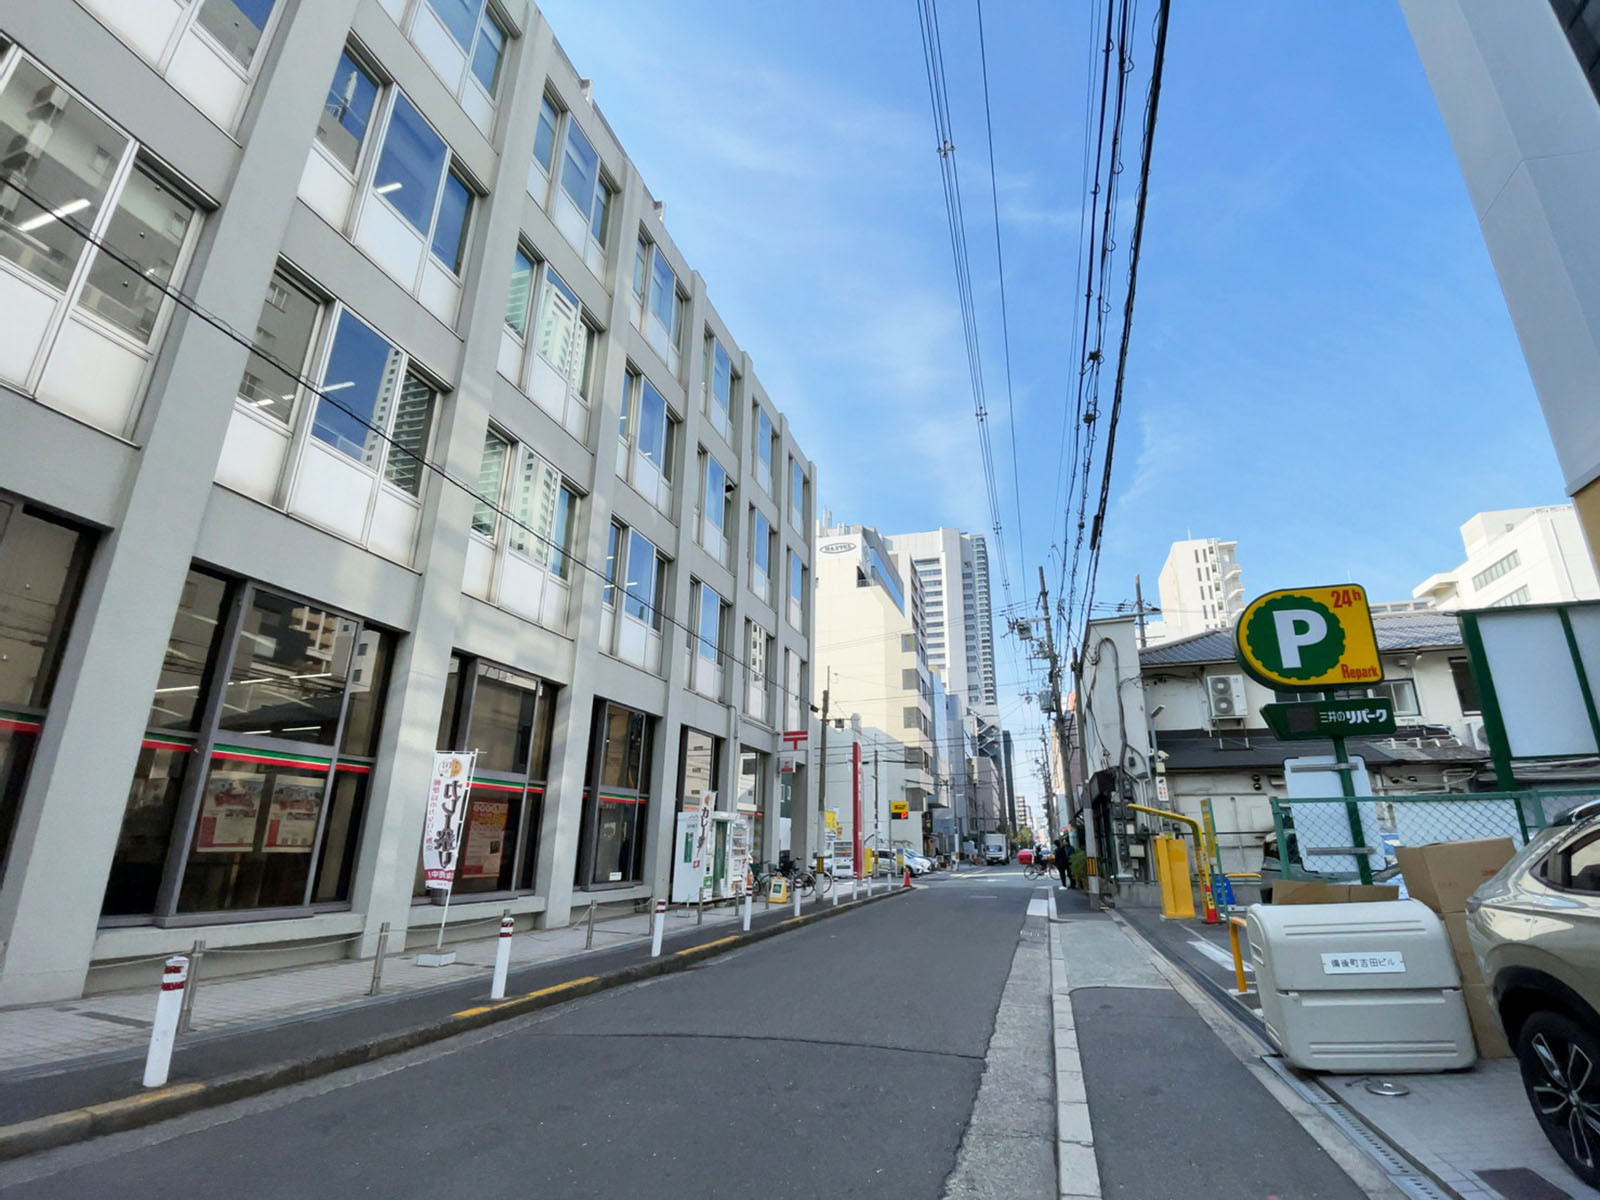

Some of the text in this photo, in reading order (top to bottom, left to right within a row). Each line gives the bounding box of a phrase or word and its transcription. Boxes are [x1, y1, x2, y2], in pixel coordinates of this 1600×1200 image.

[1331, 589, 1362, 608] 24h
[1272, 609, 1328, 669] P
[1341, 664, 1379, 680] Repark
[1319, 708, 1388, 724] 三井のリパーク
[1331, 958, 1396, 968] 備後町吉田ビル
